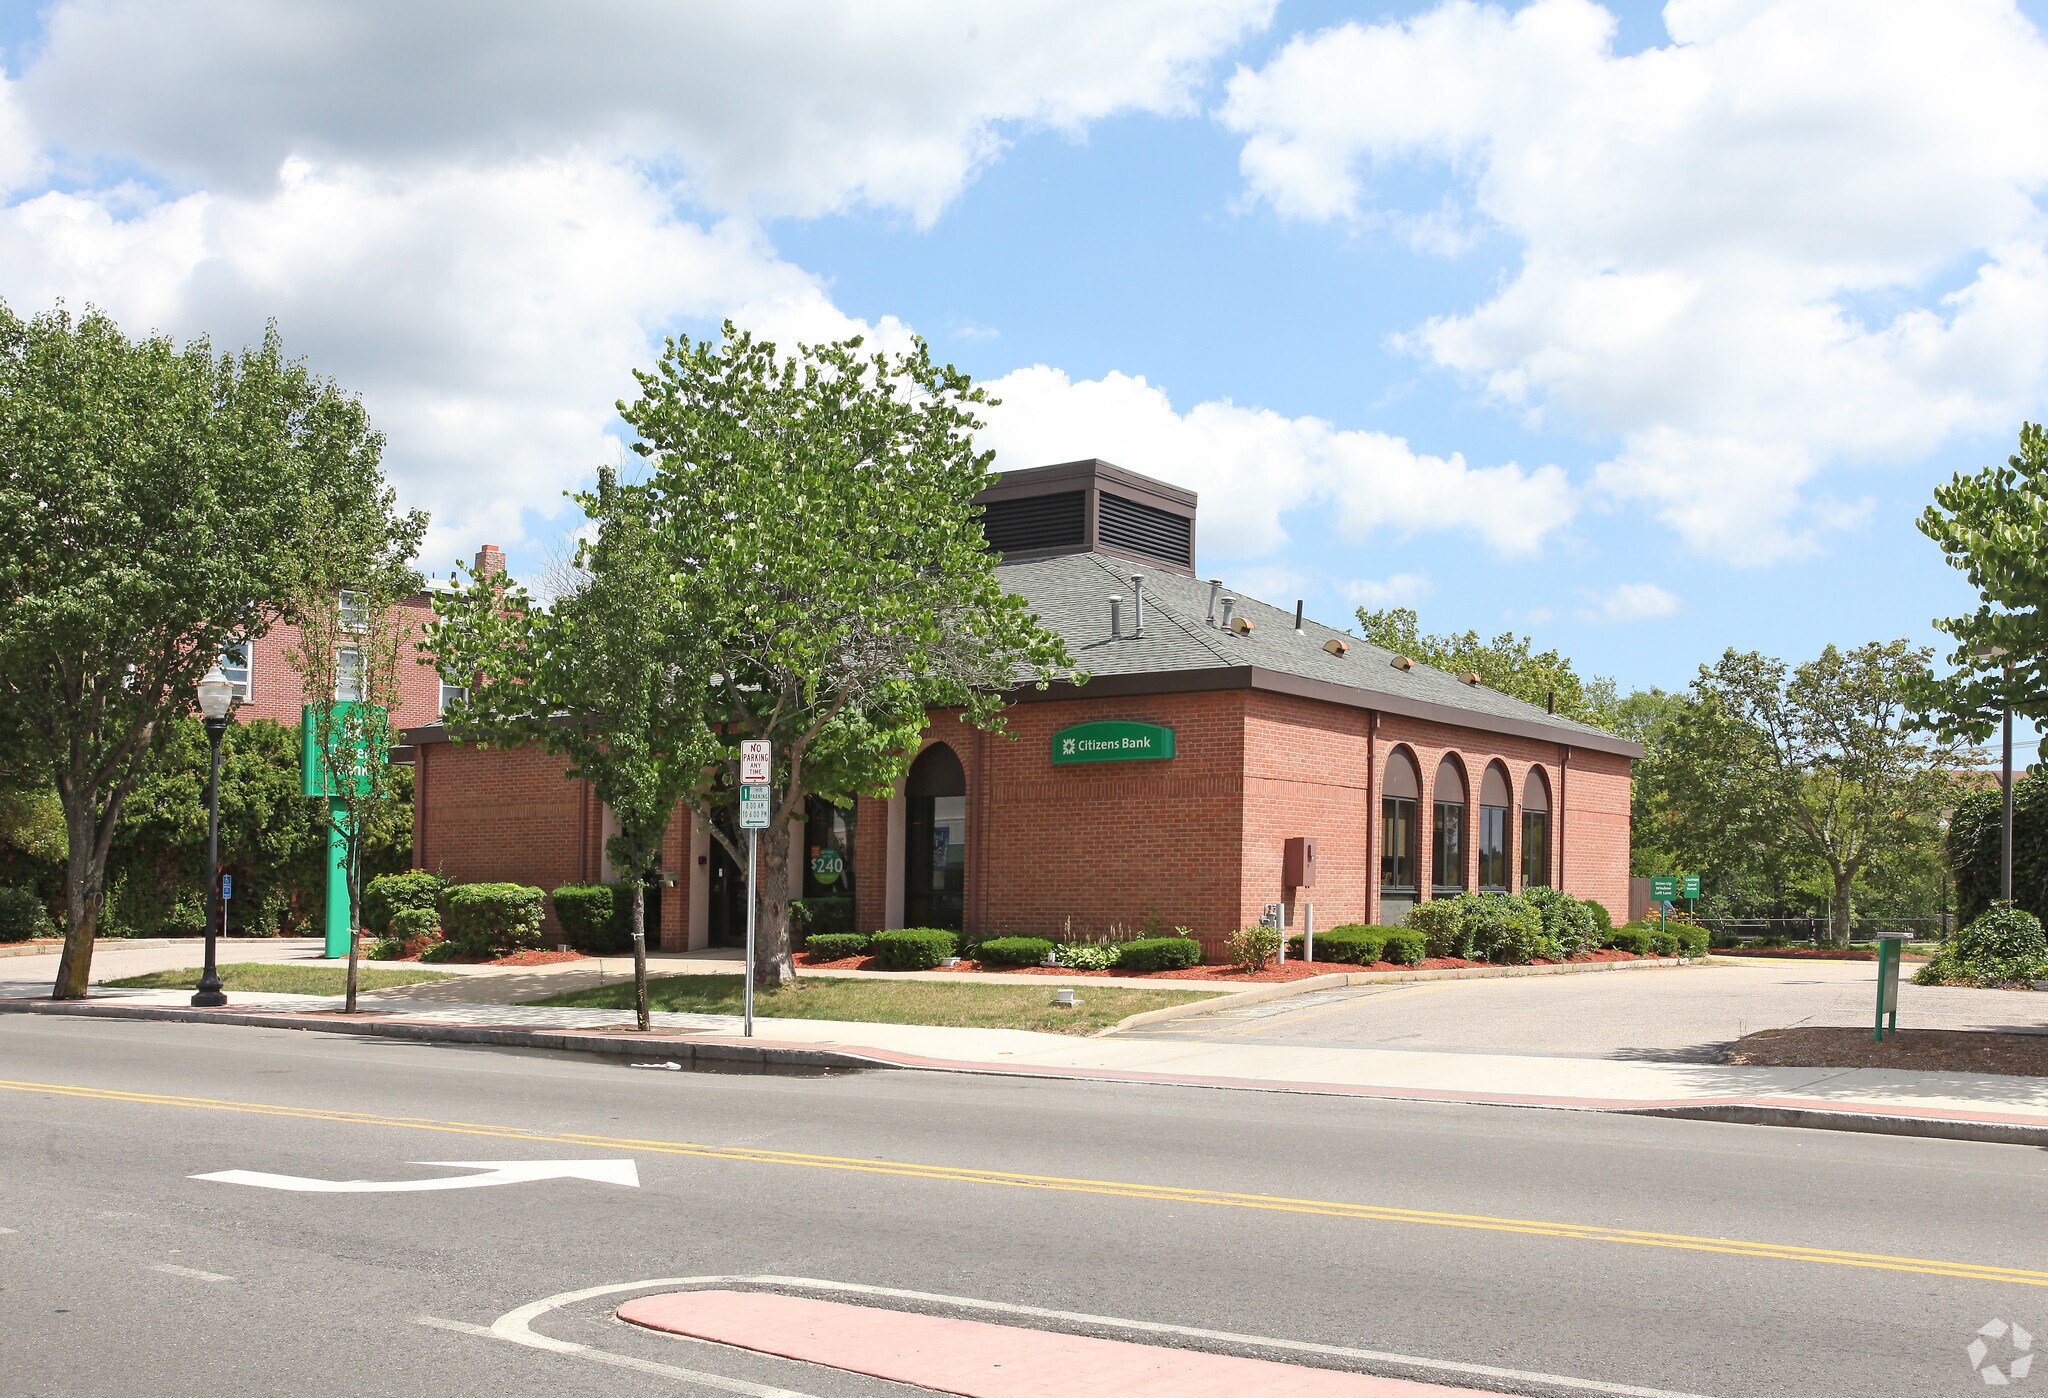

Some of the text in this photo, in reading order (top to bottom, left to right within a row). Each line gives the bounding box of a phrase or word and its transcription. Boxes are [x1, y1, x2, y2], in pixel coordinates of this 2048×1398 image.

[750, 744, 762, 752] NO
[1078, 736, 1151, 751] Citizens Bank
[743, 754, 769, 762] PARKING
[811, 858, 843, 873] $240
